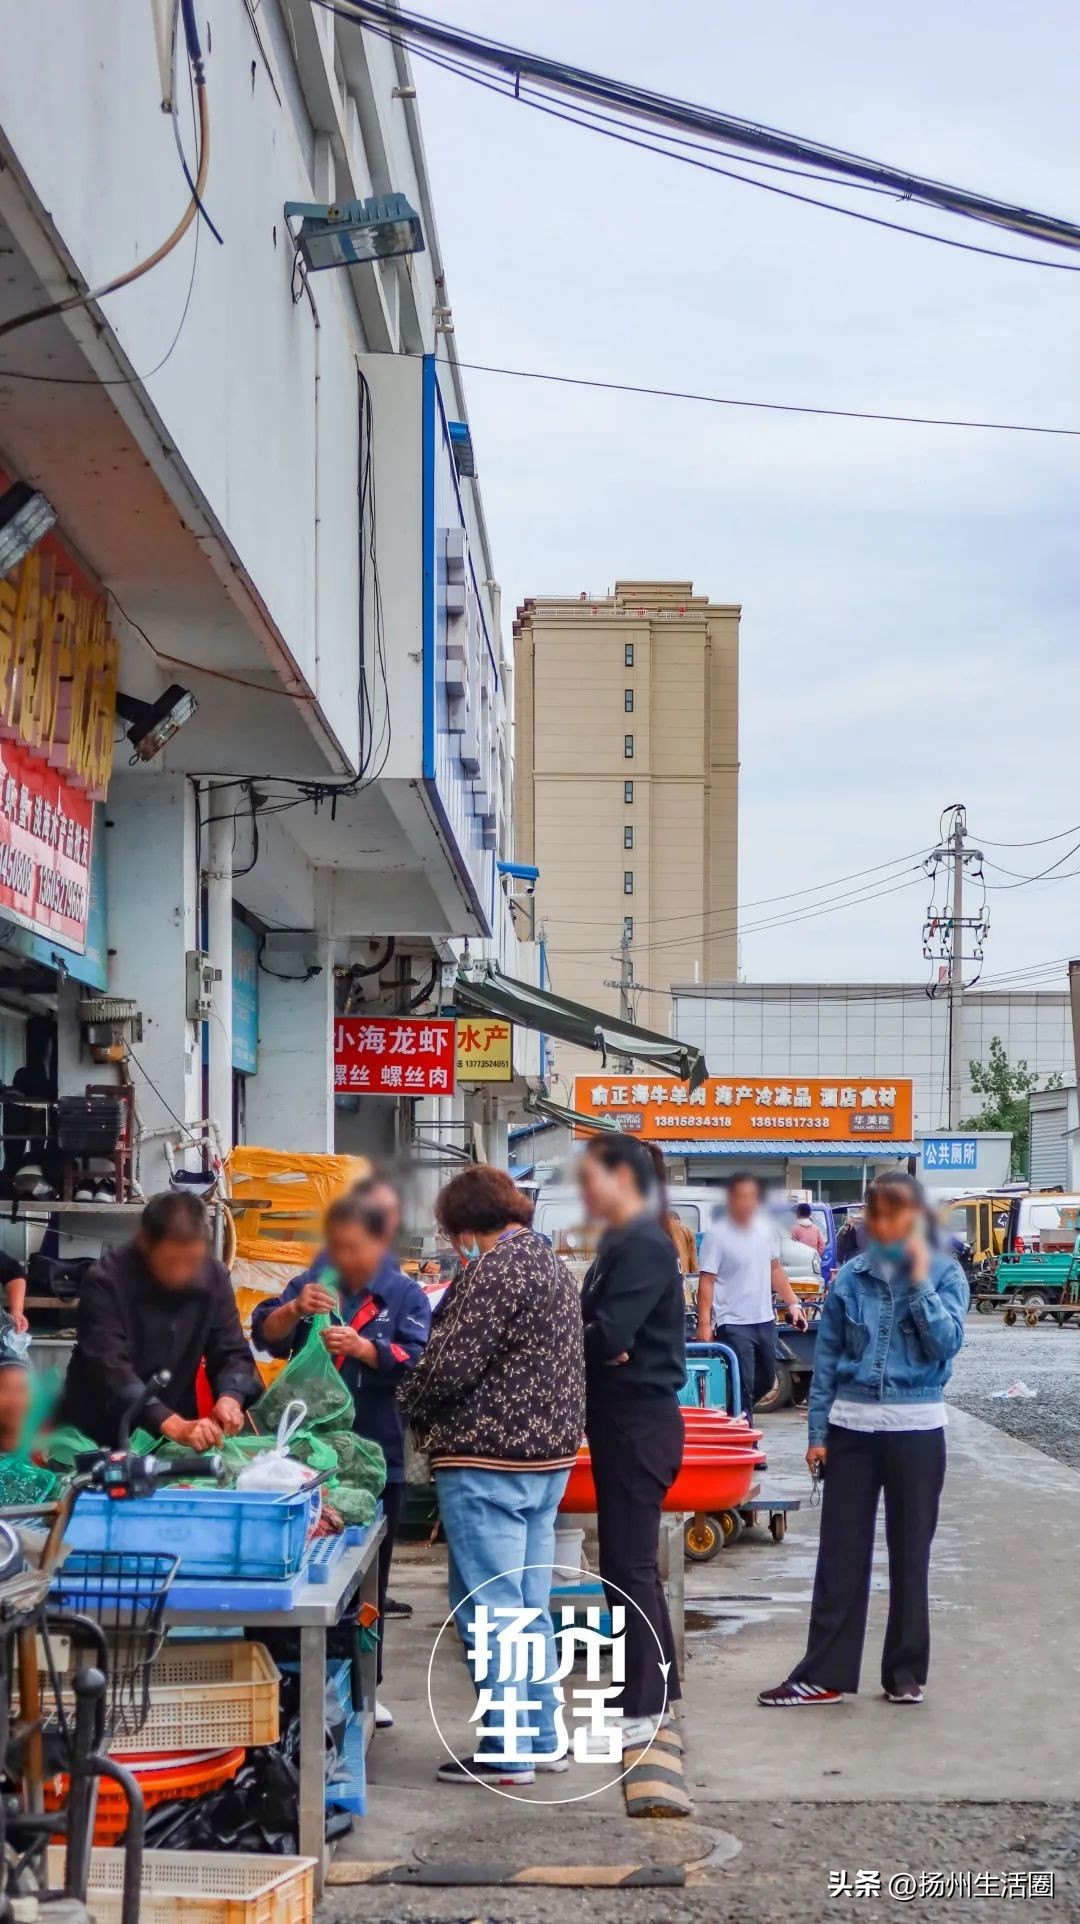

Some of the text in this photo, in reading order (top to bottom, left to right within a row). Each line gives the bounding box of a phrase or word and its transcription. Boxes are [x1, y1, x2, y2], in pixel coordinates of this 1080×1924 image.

[334, 1024, 449, 1056] 小海龙虾
[457, 1025, 509, 1053] 水产
[380, 1065, 448, 1089] 螺丝肉
[715, 1085, 812, 1108] 海产冷冻品
[820, 1086, 897, 1108] 酒店食材
[654, 1116, 732, 1127] 13815834318
[750, 1116, 830, 1128] 13815817338
[926, 1142, 976, 1165] 公共厕所
